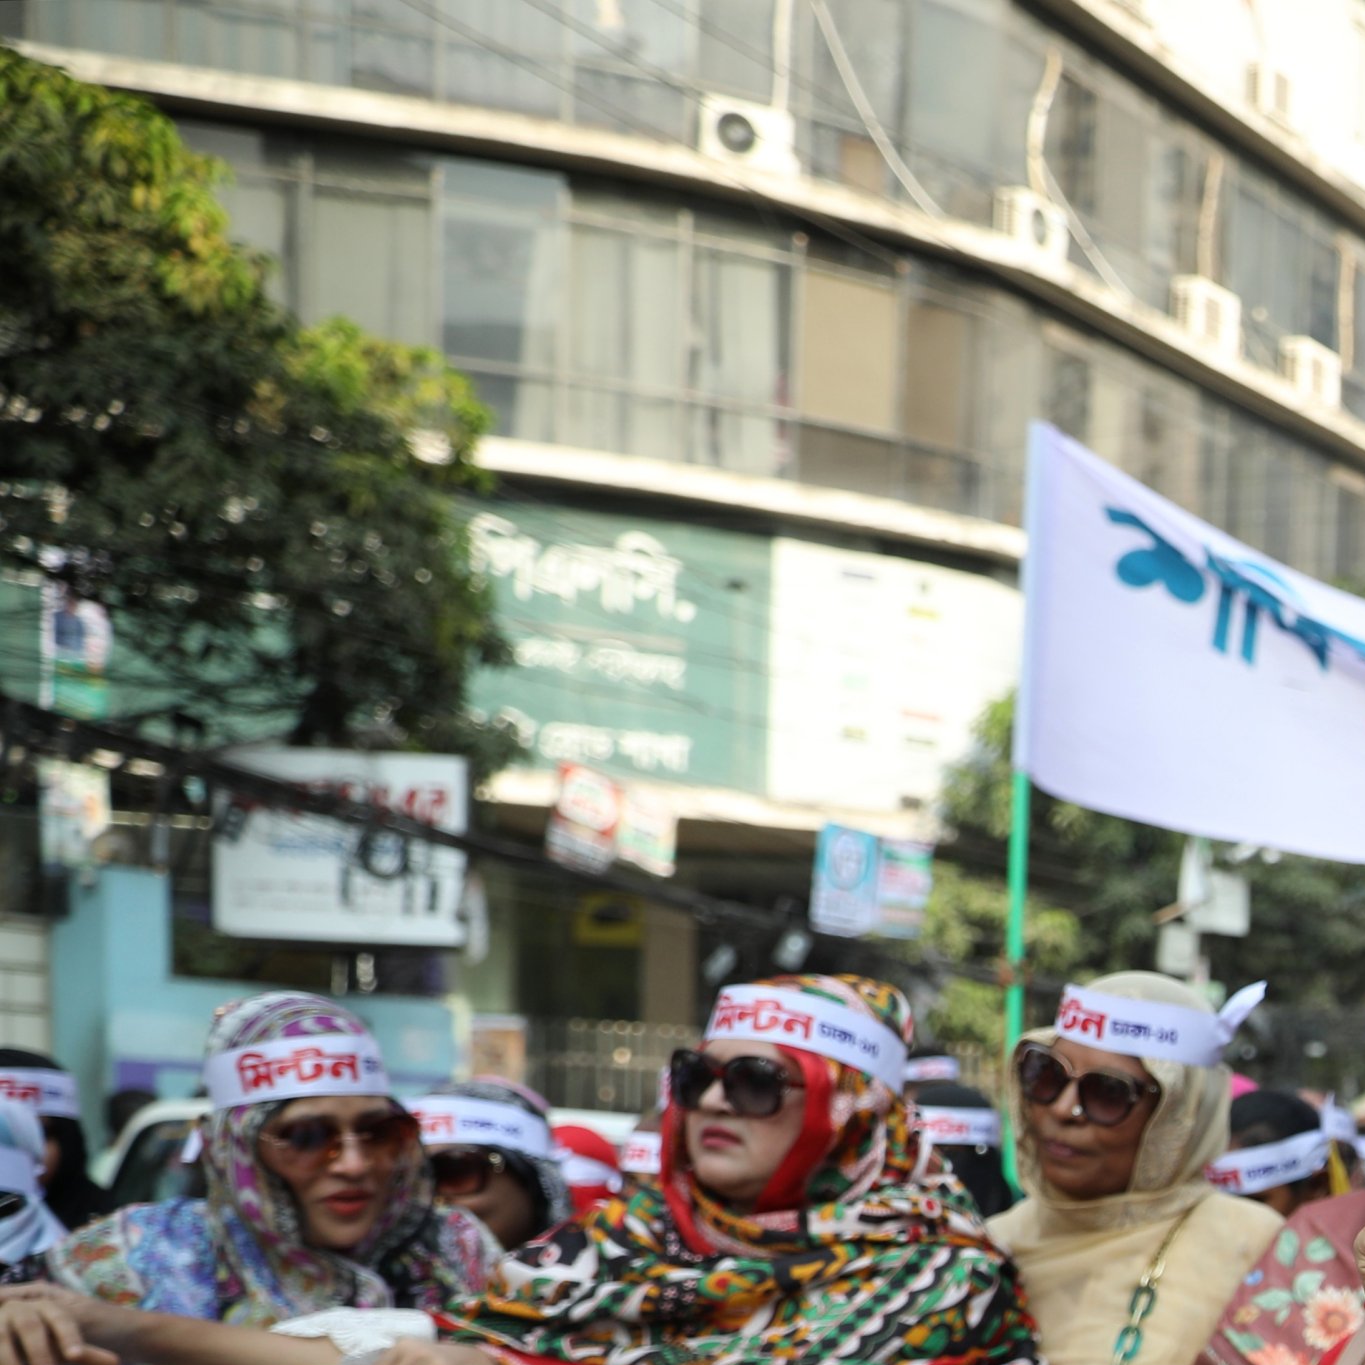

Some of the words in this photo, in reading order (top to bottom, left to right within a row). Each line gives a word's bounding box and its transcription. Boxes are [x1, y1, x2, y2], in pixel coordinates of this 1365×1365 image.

[712, 994, 814, 1042] মিল্টন
[1058, 998, 1107, 1041] টন
[236, 1048, 361, 1092] মিল্টন
